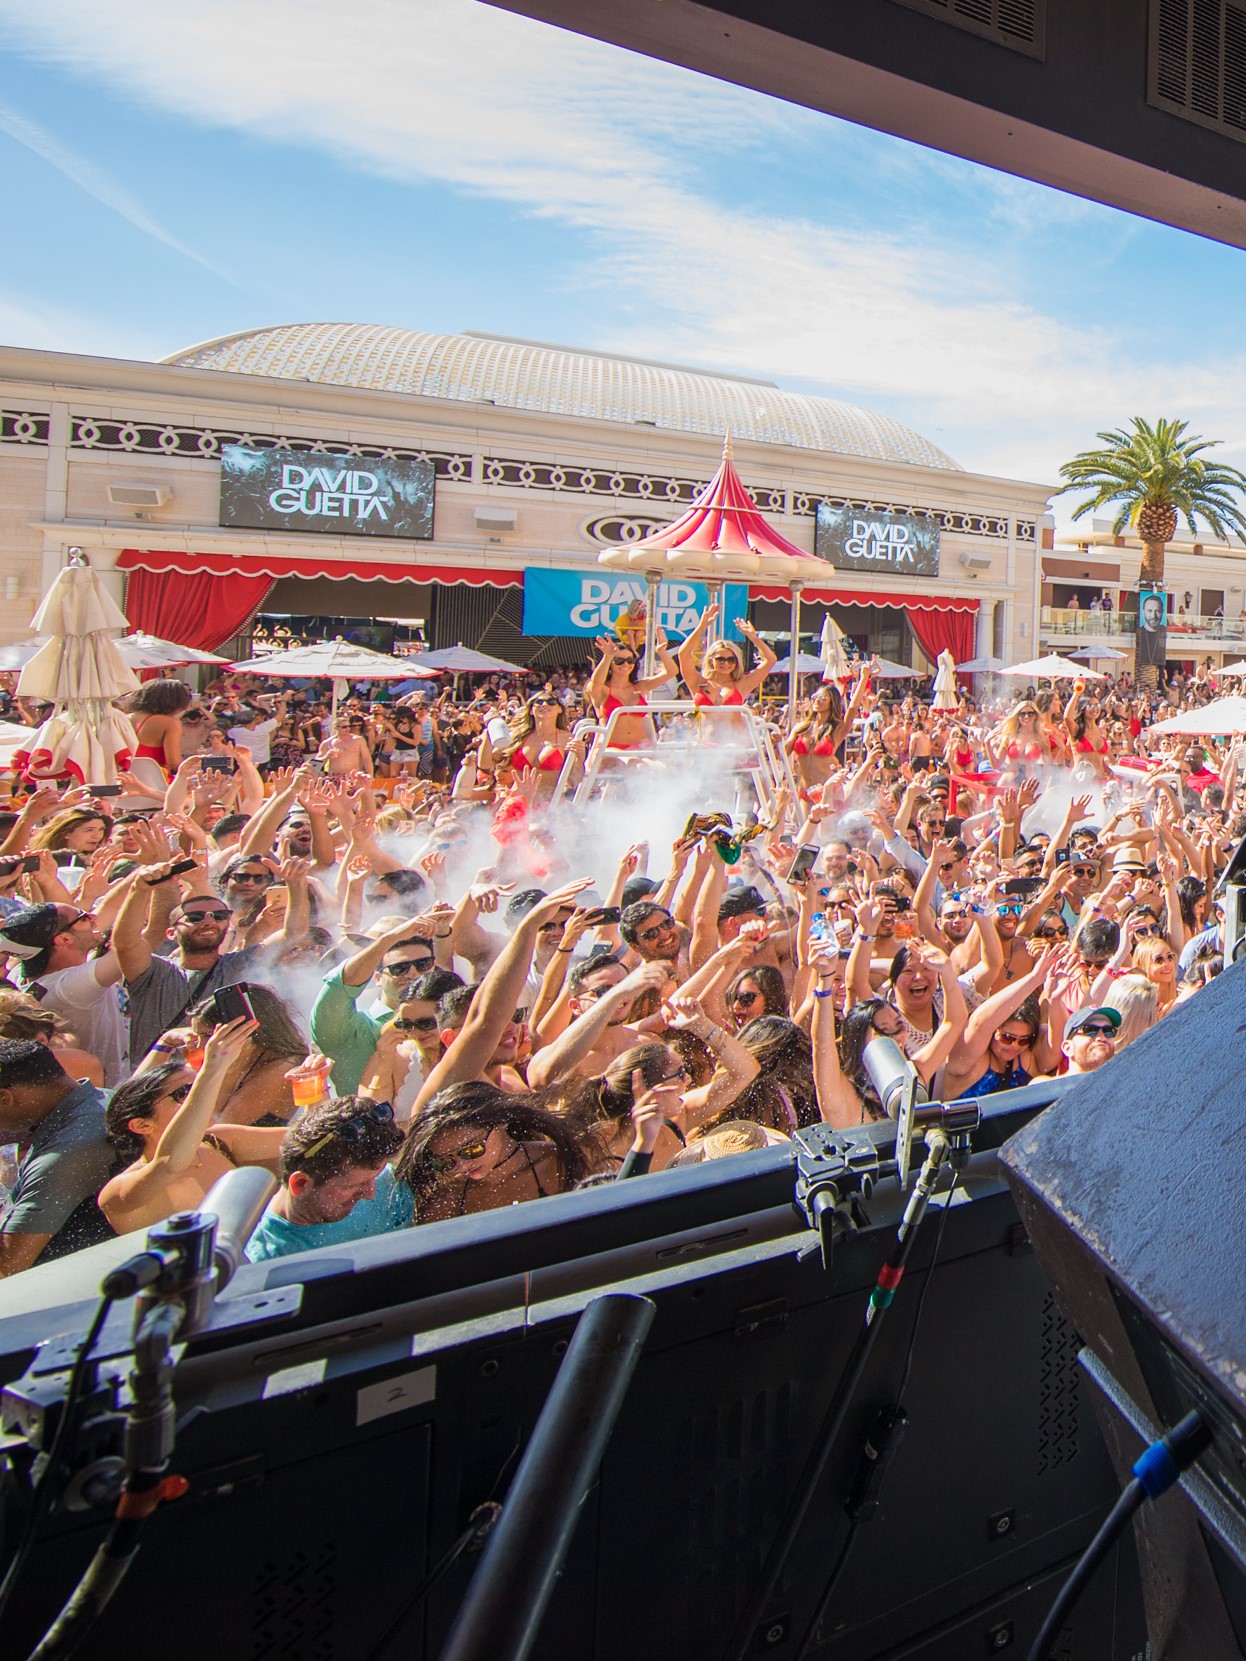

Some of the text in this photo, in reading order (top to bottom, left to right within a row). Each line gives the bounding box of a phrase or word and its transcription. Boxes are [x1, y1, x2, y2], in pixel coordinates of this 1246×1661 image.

[282, 464, 379, 495] DAVID
[269, 488, 389, 520] GUETTA
[852, 519, 909, 543] DAVID
[844, 538, 915, 563] GUETTA
